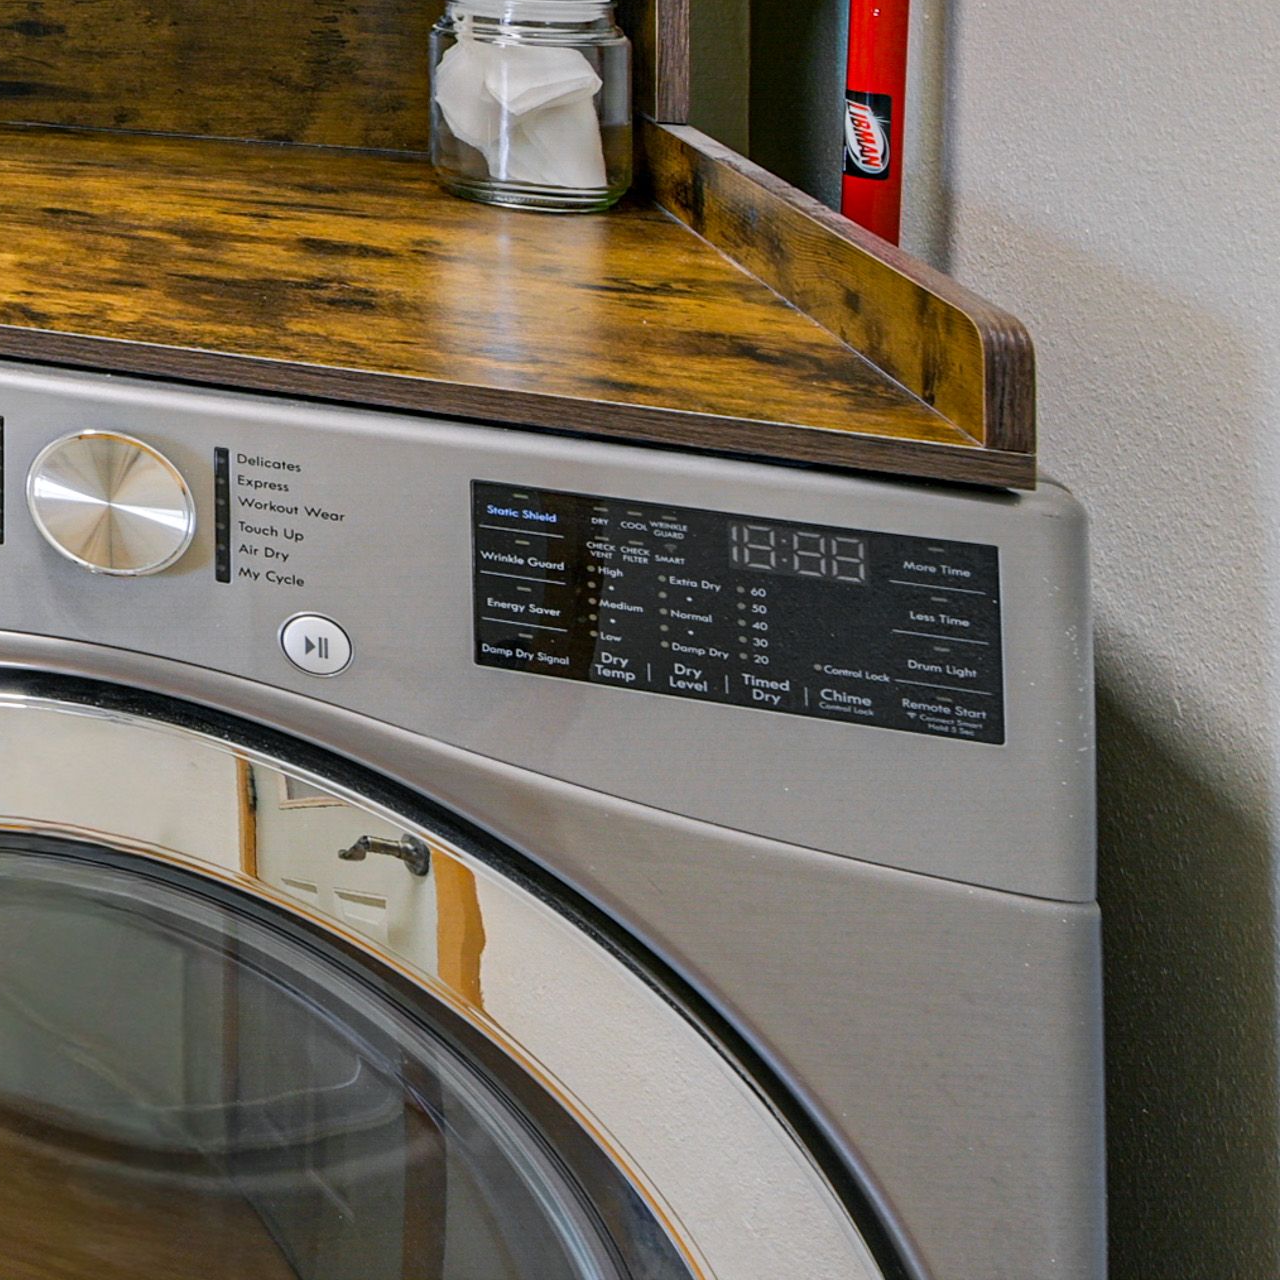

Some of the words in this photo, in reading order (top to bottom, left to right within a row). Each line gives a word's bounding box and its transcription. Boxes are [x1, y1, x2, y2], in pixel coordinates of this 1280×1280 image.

[237, 453, 301, 472] Delicates
[237, 475, 289, 492] Express
[237, 496, 298, 515] Workout
[304, 506, 345, 521] Wear
[487, 504, 519, 518] Static
[522, 509, 557, 523] Shield
[238, 521, 278, 537] Touch
[283, 528, 304, 543] Up
[591, 517, 609, 526] DRY
[620, 521, 648, 532] COOL
[650, 521, 688, 532] WRINKLE
[653, 530, 684, 539] GUARD
[239, 544, 259, 556] Air
[265, 547, 289, 562] Dry
[586, 541, 616, 552] CHECK
[620, 546, 650, 556] CHECK
[480, 550, 524, 565] Wrinkle
[527, 557, 565, 571] Guard
[590, 550, 612, 560] VENT
[622, 555, 648, 564] FILTER
[654, 554, 685, 565] SMART
[239, 567, 260, 581] My
[265, 570, 304, 587] Cycle
[598, 566, 623, 578] High
[903, 561, 937, 573] More
[940, 565, 971, 578] Time
[669, 576, 698, 588] Extra
[701, 580, 721, 592] Dry
[750, 587, 767, 598] 60
[487, 597, 525, 613] Energy
[528, 604, 560, 616] Saver
[598, 600, 644, 613] Medium
[751, 604, 768, 614] 50
[670, 609, 712, 623] Normal
[909, 610, 935, 622] Less
[939, 614, 970, 627] Time
[752, 622, 768, 631] 40
[600, 632, 622, 642] Low
[753, 638, 769, 648] 30
[482, 643, 513, 658] Damp
[515, 649, 534, 661] Dry
[537, 651, 570, 665] Signal
[671, 642, 706, 656] Damp
[708, 648, 729, 660] Dry
[601, 652, 629, 668] Dry
[753, 654, 769, 665] 20
[595, 664, 636, 682] Temp
[674, 663, 702, 679] Dry
[824, 664, 862, 679] Control
[865, 671, 890, 683] Lock
[908, 659, 942, 672] Drum
[946, 664, 977, 678] Light
[670, 675, 708, 692] Level
[741, 673, 790, 692] Timed
[752, 689, 781, 706] Dry
[820, 688, 872, 707] Chime
[818, 701, 851, 713] Control
[853, 705, 874, 716] Lock
[902, 698, 951, 714] Remote
[955, 706, 987, 719] Start
